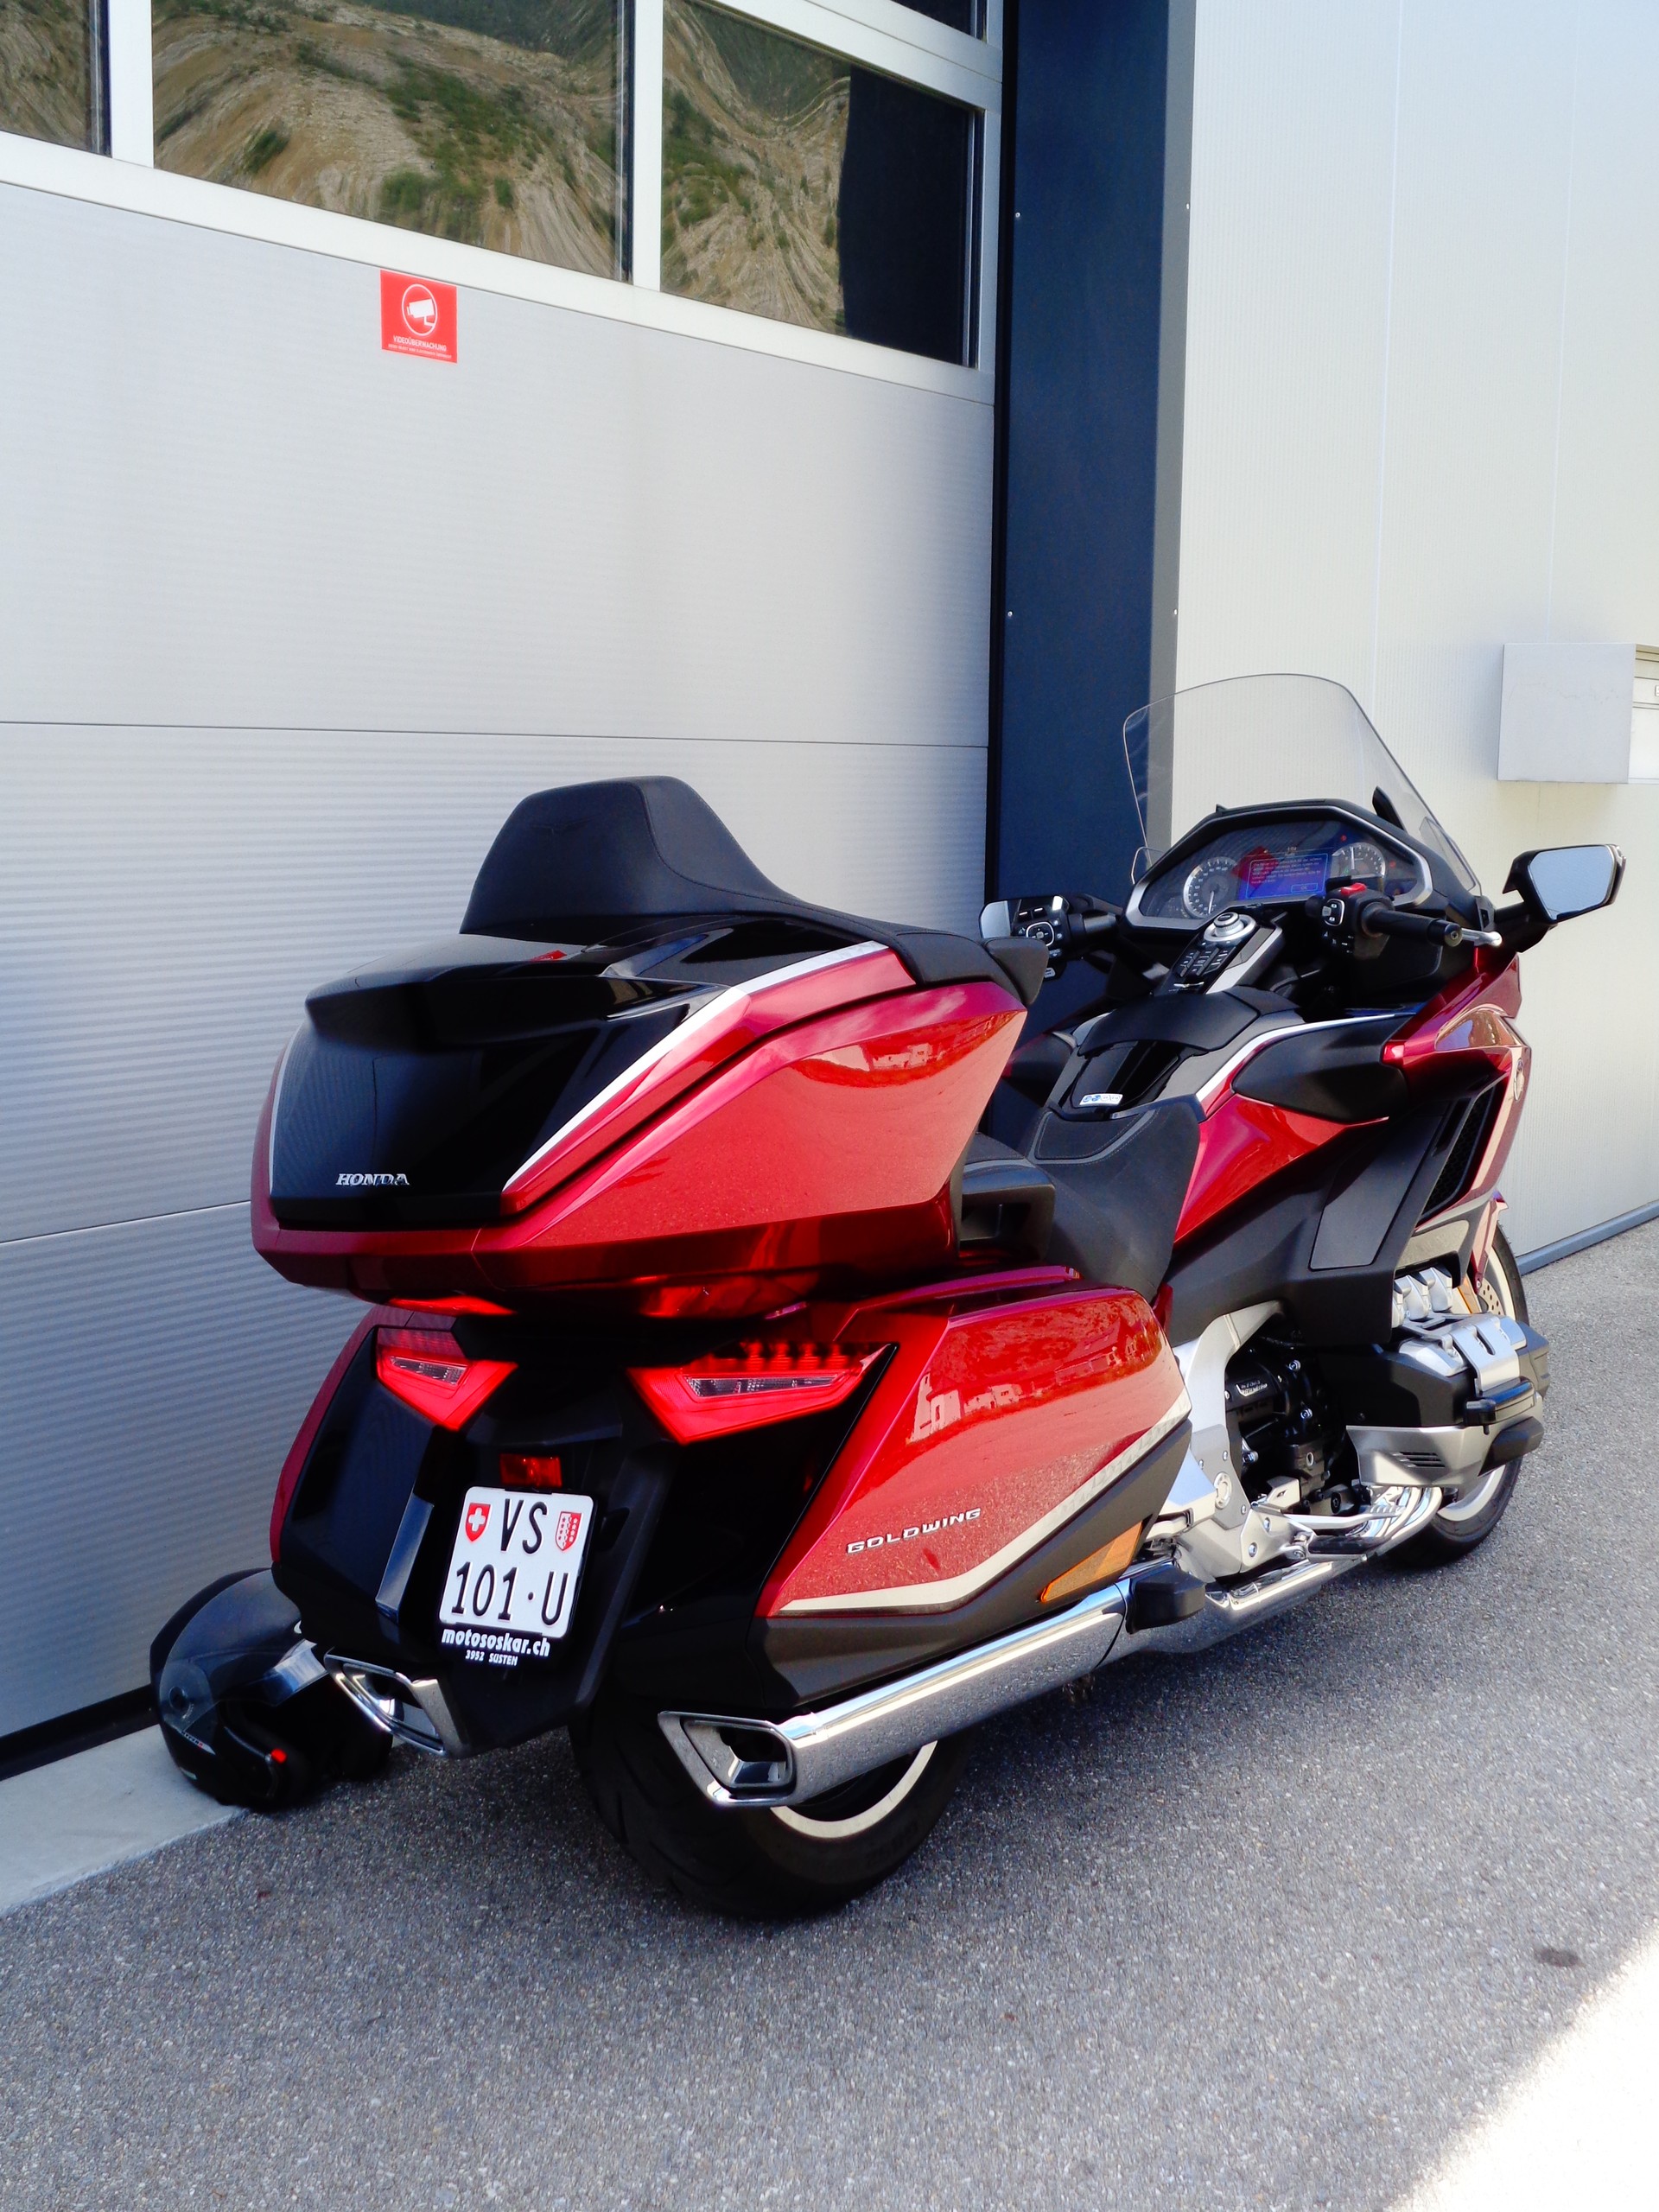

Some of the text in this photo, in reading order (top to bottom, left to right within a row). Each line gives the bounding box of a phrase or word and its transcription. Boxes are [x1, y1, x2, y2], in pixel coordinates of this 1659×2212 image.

[392, 334, 448, 352] VIDEOÜBERWACHUNG
[335, 1173, 410, 1186] HONDA
[500, 1497, 548, 1554] VS
[846, 1507, 982, 1554] GOLDWING
[441, 1628, 551, 1657] motososkar.ch
[465, 1649, 485, 1662] 3952
